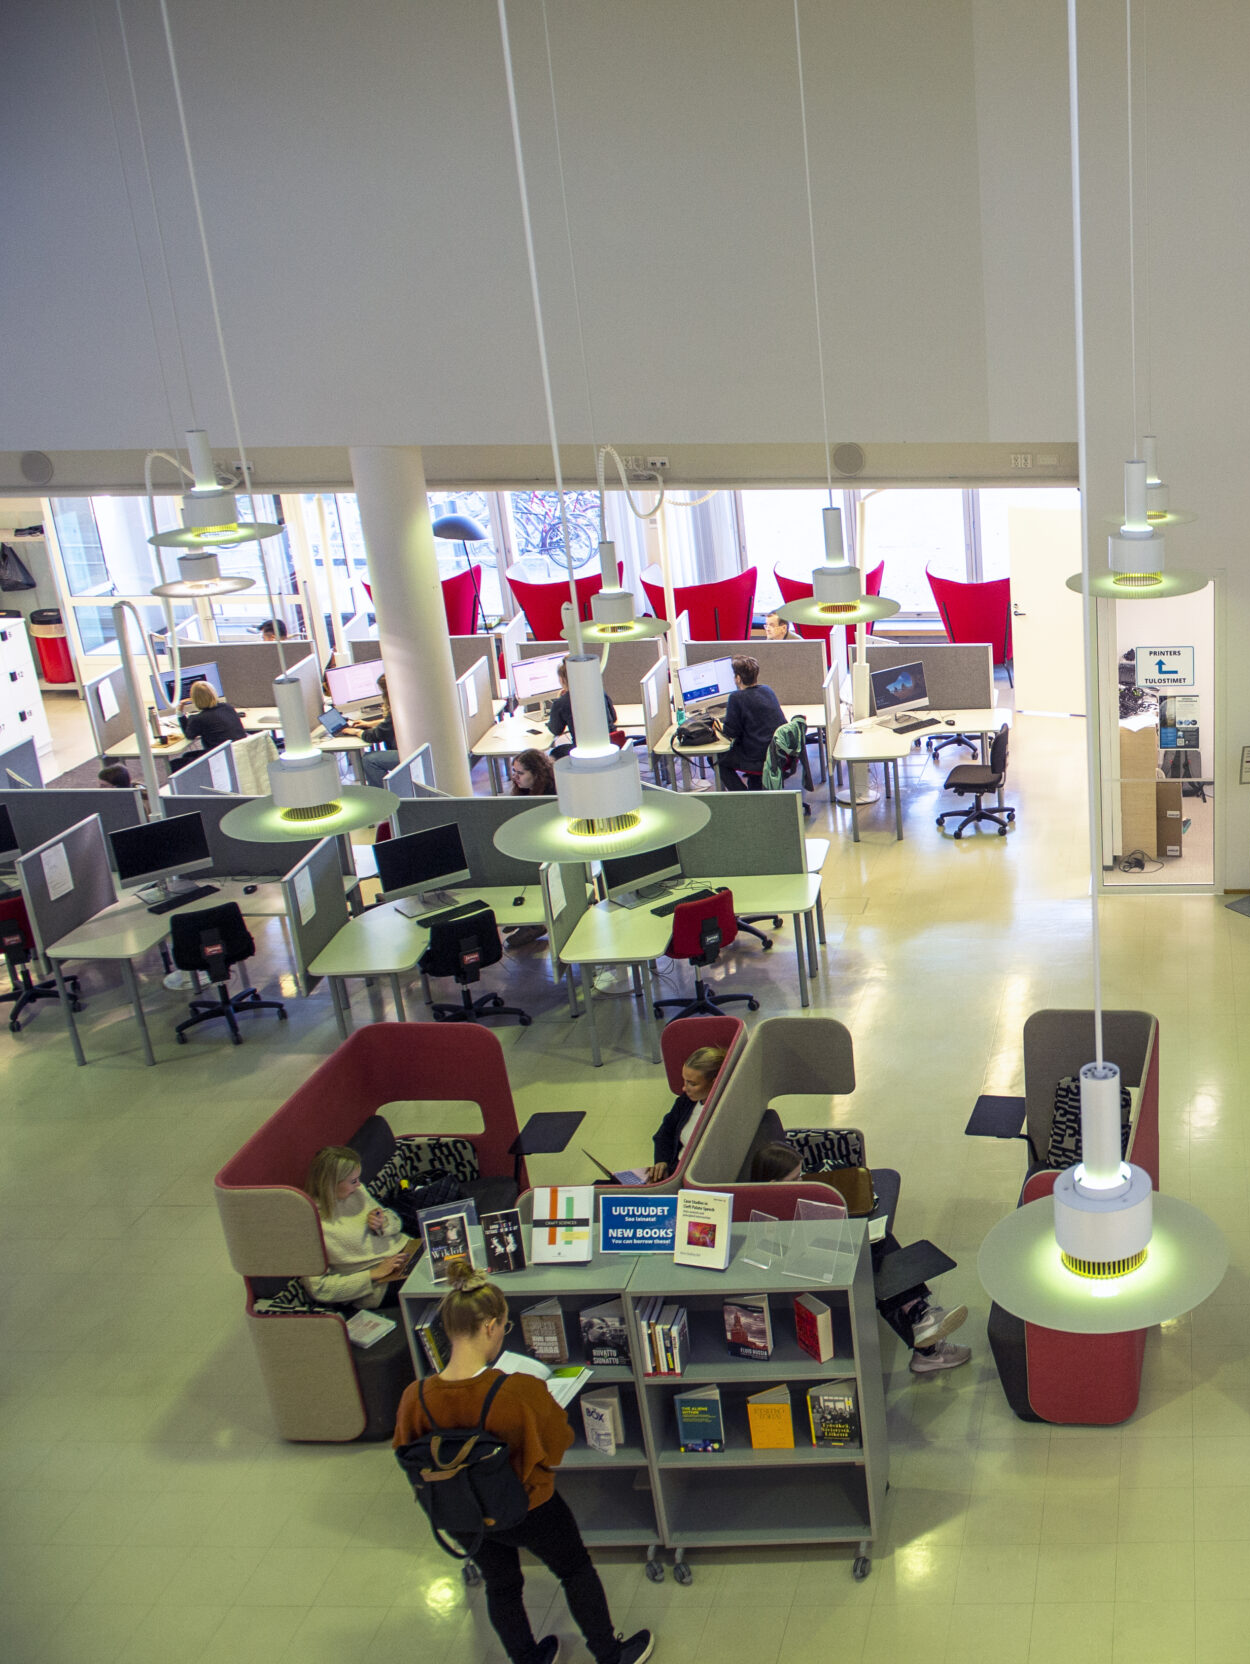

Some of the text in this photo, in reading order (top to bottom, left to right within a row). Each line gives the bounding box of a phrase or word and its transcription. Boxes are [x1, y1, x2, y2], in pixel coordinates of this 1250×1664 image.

[612, 1206, 669, 1215] UUTUUDET
[608, 1229, 673, 1237] NEW BOOKS
